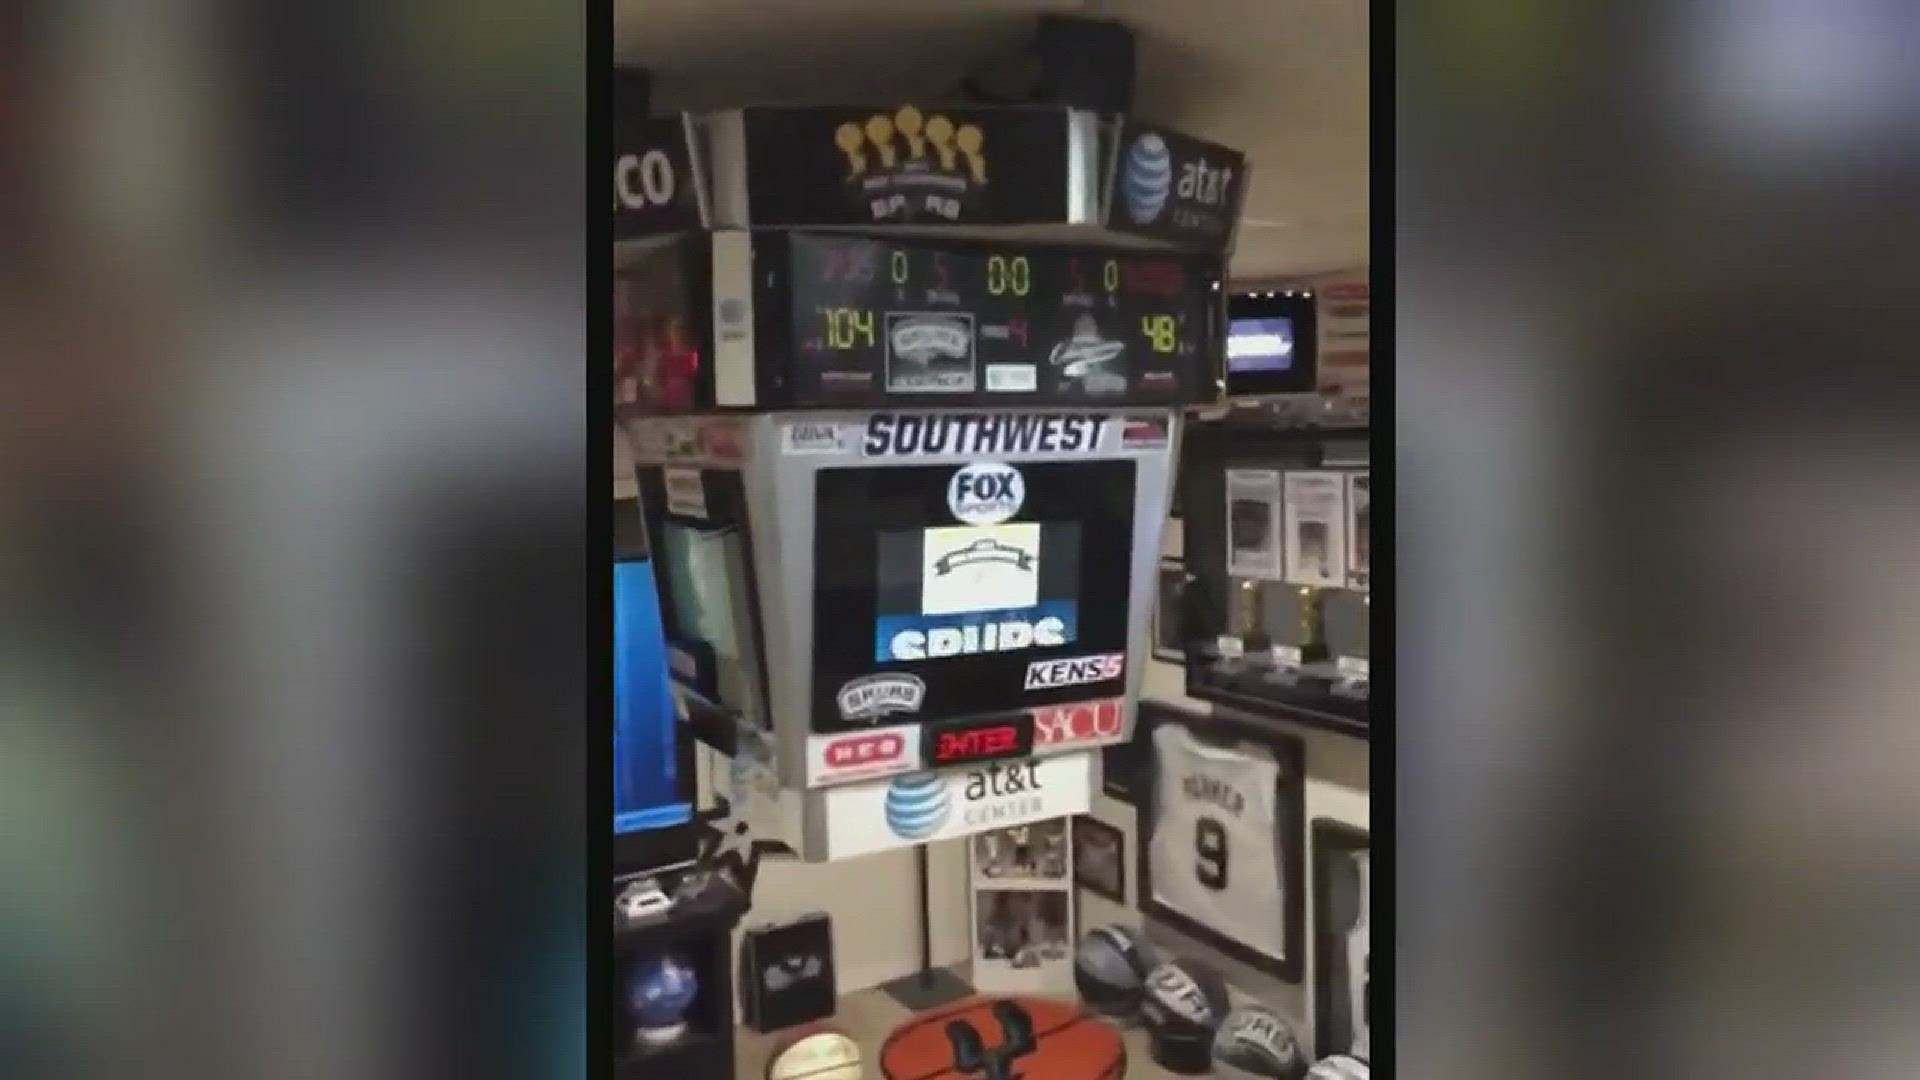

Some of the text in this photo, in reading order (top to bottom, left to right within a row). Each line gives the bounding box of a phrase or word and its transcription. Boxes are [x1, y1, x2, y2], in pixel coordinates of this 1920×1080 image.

[891, 250, 908, 283] 0
[1104, 259, 1119, 292] 0
[825, 307, 875, 350] 104
[1141, 315, 1176, 352] 48
[865, 412, 1109, 457] SOUTHWEST
[957, 472, 1016, 501] FOX
[965, 757, 1043, 802] at&t
[1195, 817, 1229, 892] 9
